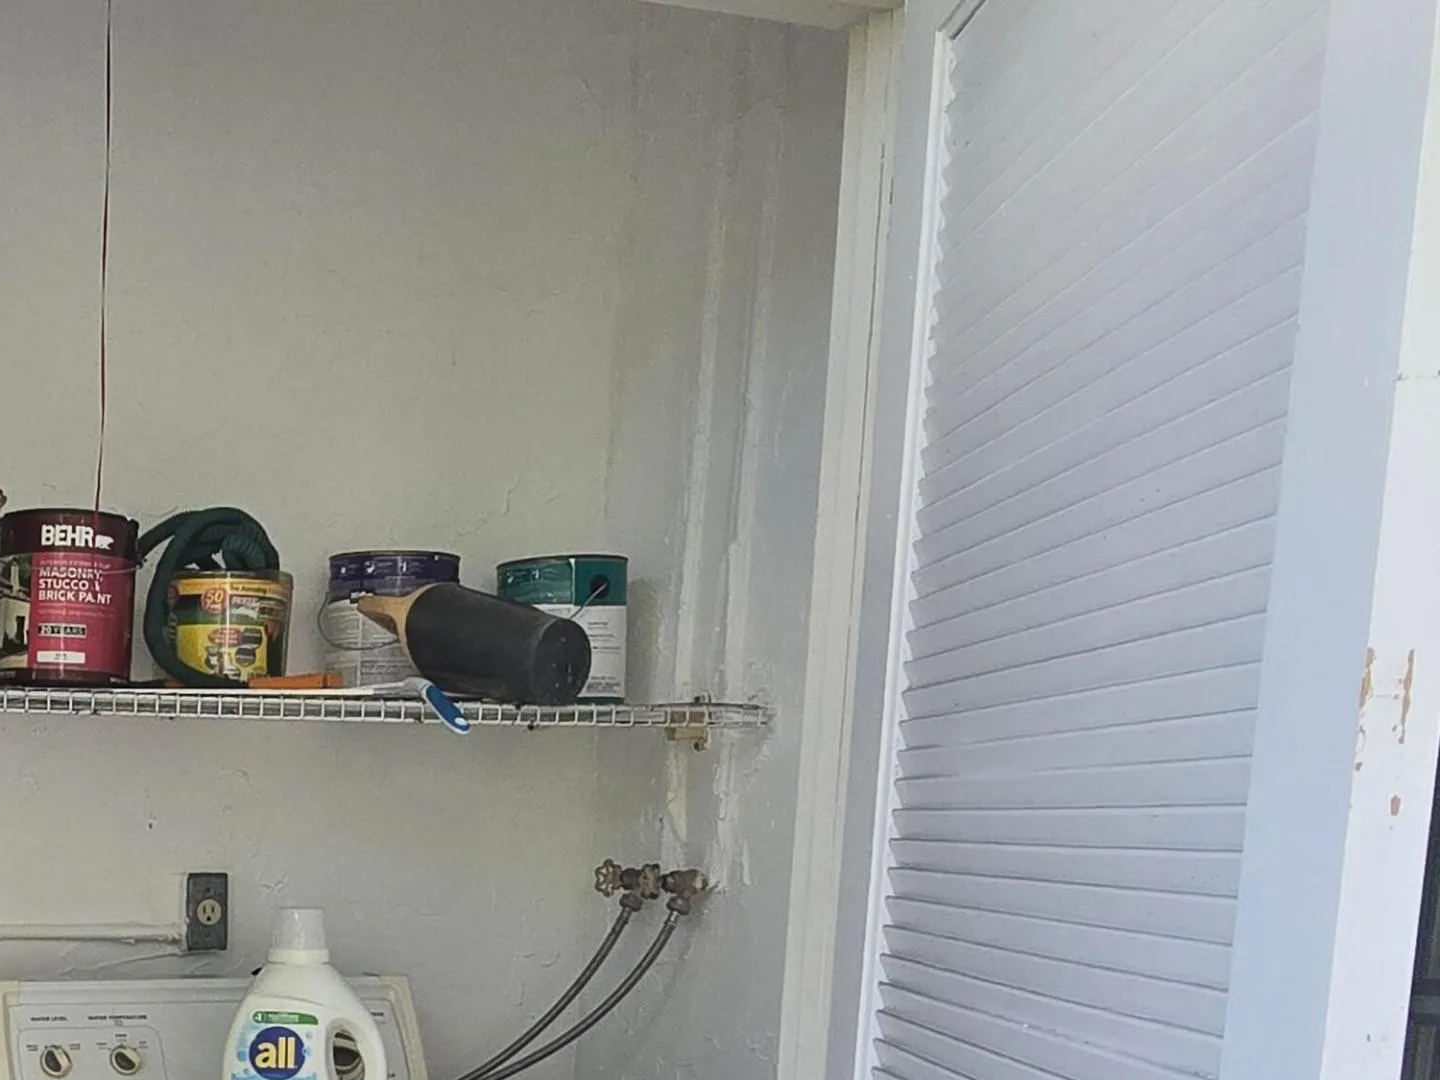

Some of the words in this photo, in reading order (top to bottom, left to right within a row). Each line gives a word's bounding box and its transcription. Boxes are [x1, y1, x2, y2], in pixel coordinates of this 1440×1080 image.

[40, 524, 93, 547] BEHR
[38, 578, 90, 591] STUCCO
[38, 589, 76, 602] BRICK
[78, 591, 112, 605] PANT
[205, 588, 224, 602] 50
[254, 1036, 296, 1069] all
